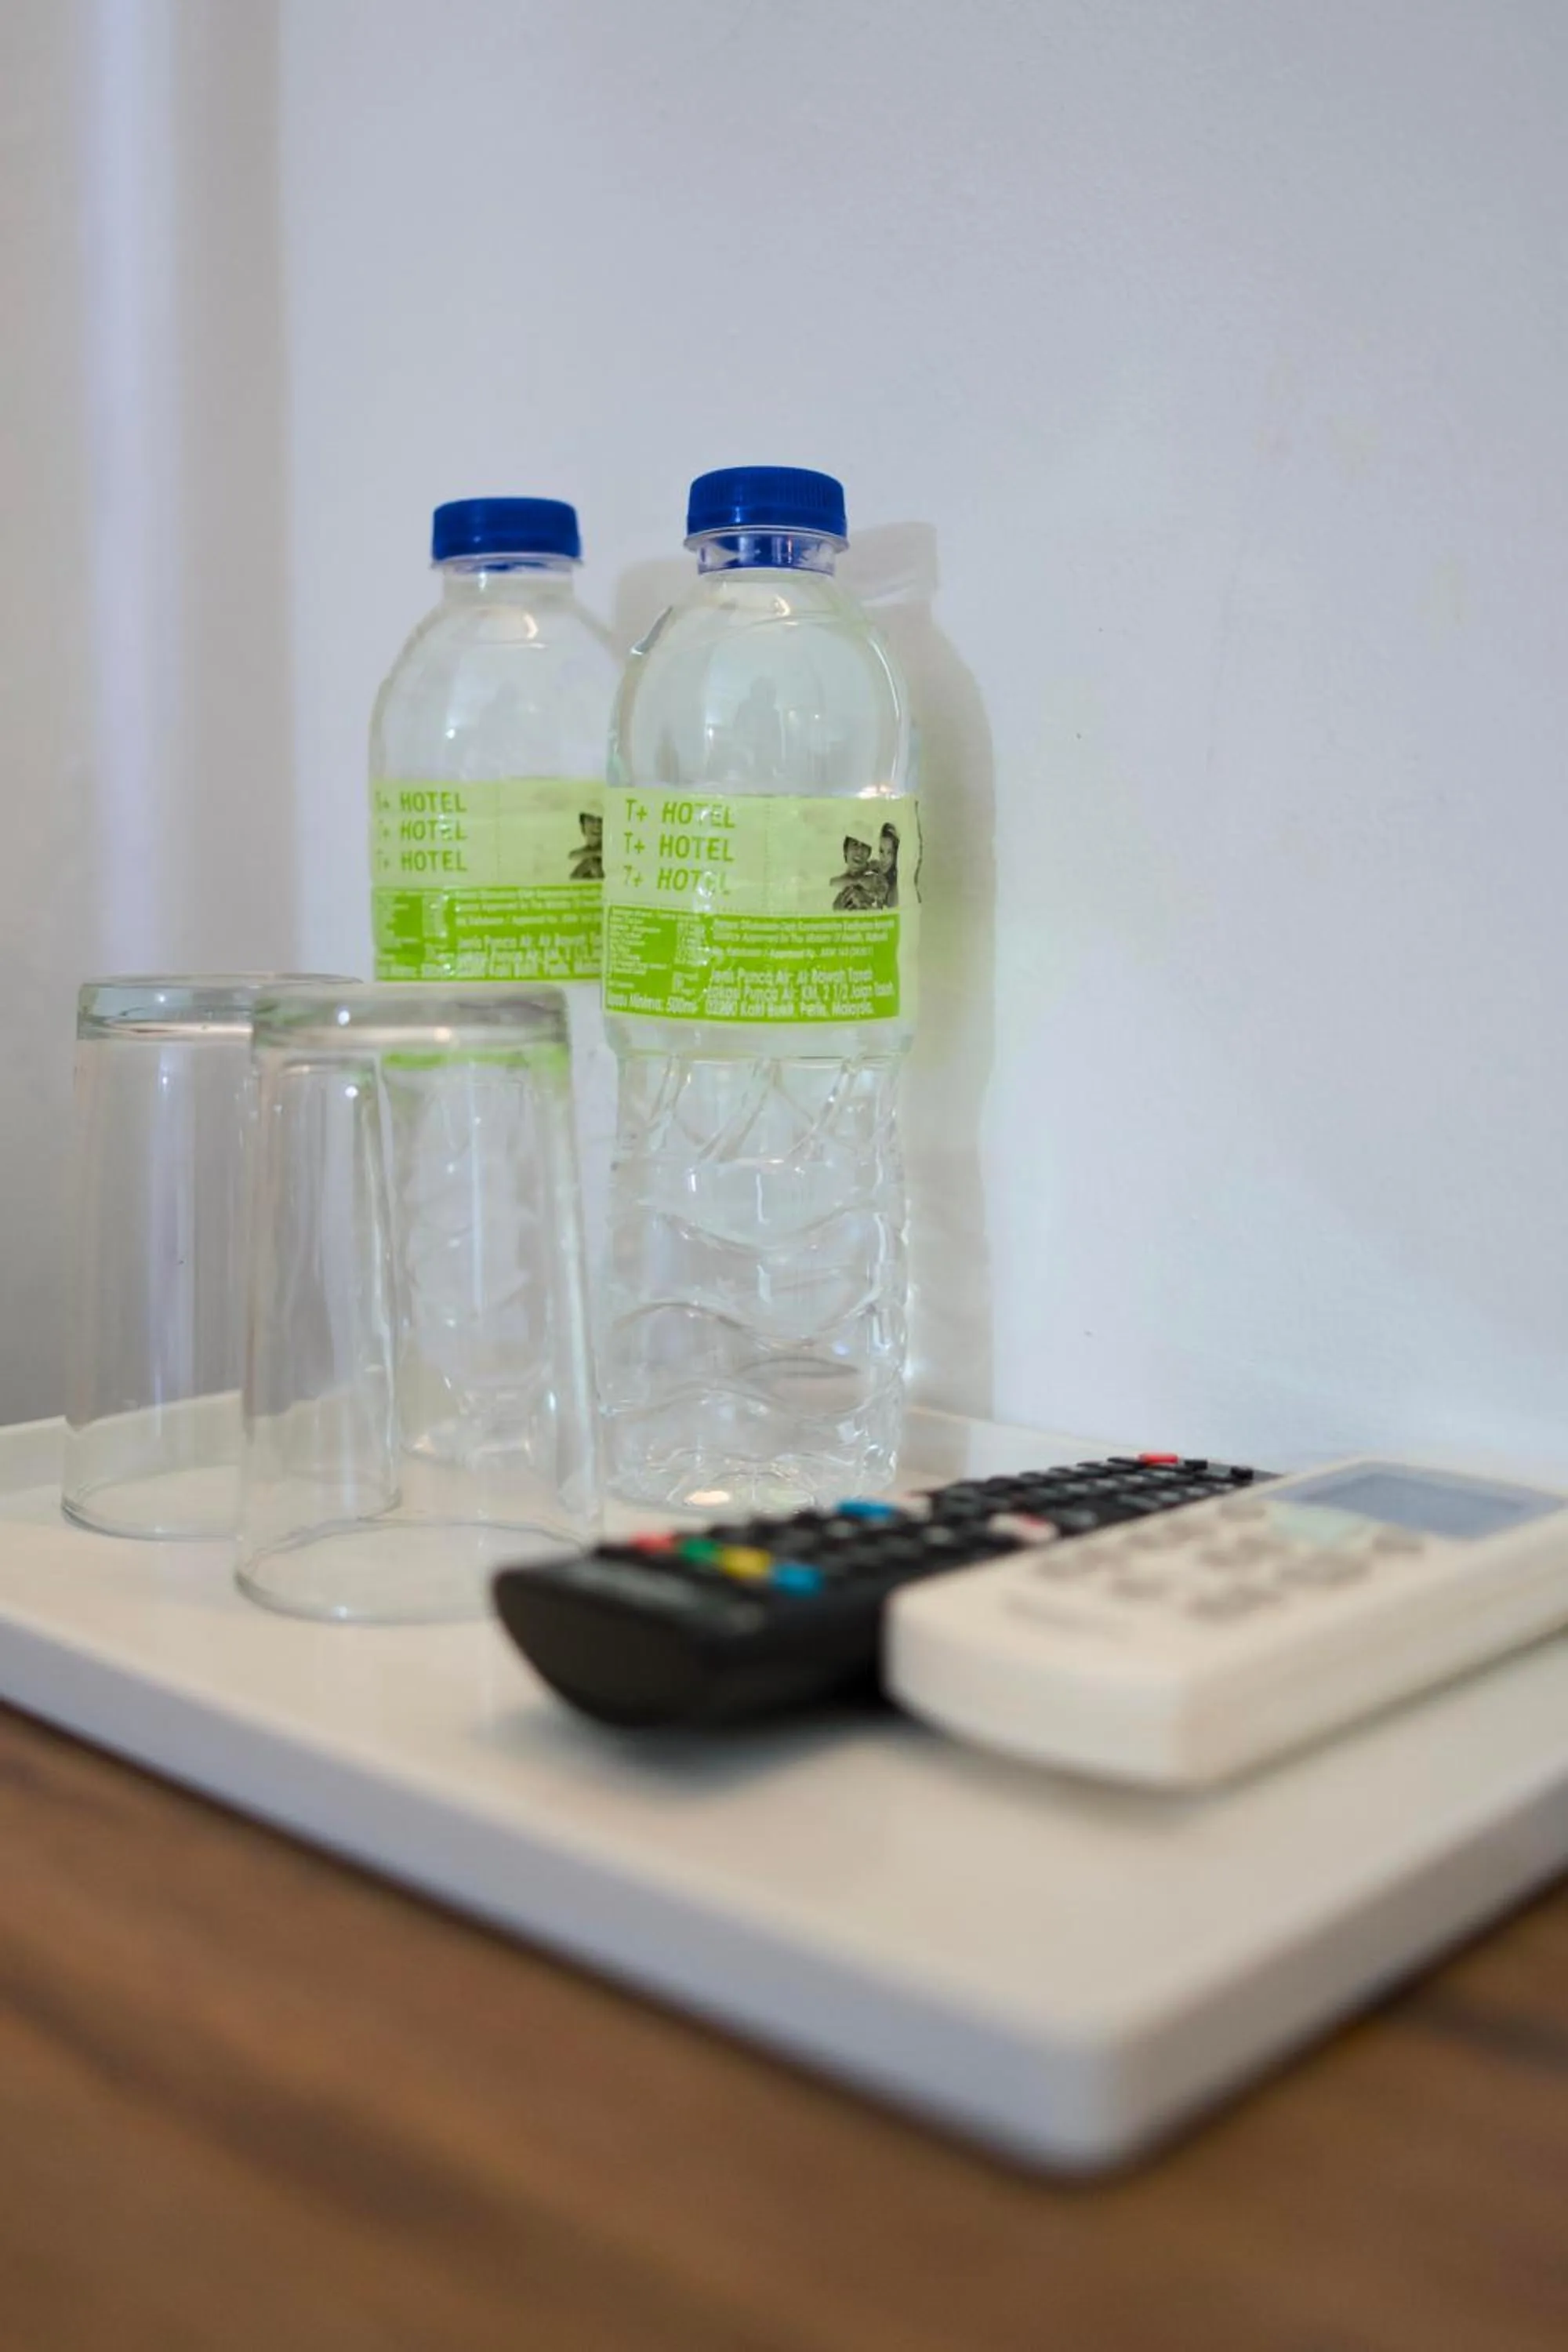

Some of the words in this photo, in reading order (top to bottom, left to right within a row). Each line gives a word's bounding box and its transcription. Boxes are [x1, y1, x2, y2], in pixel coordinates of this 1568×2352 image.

[400, 791, 468, 812] HOTEL
[626, 798, 647, 822] T+
[662, 801, 735, 828] HOTEL
[401, 820, 469, 840] HOTEL
[623, 832, 645, 855] T+
[659, 833, 735, 862] HOTEL
[401, 850, 468, 873] HOTEL
